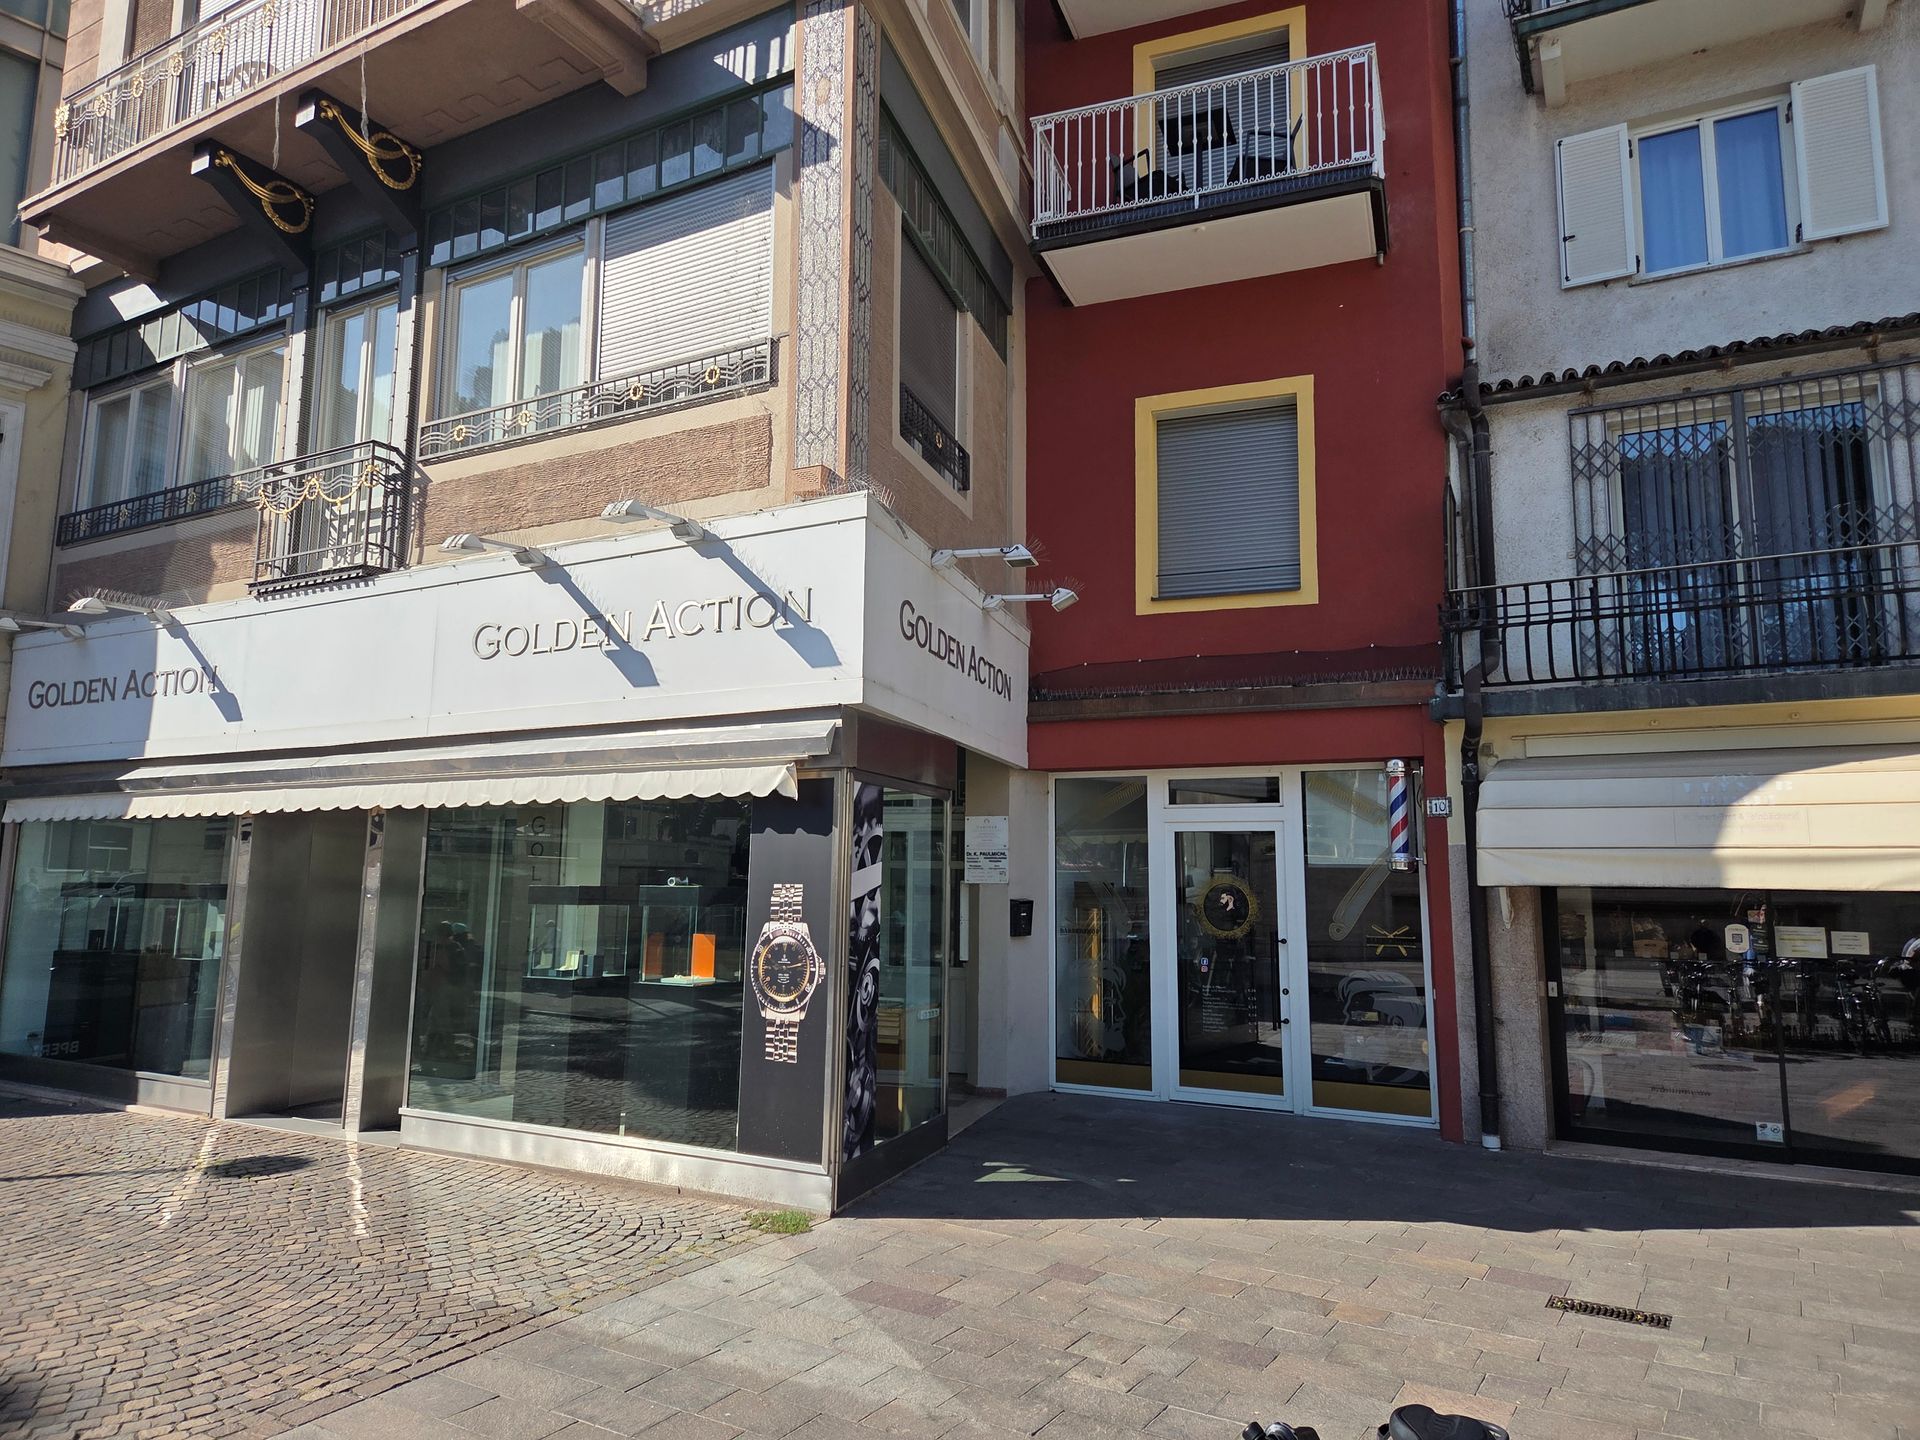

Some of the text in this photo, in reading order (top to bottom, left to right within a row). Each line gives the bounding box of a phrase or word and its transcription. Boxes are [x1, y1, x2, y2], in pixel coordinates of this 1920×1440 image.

[472, 587, 813, 660] GOLDEN ACTION
[899, 599, 1012, 702] GOLDEN ACTION
[28, 665, 219, 709] GOLDEN ACTION
